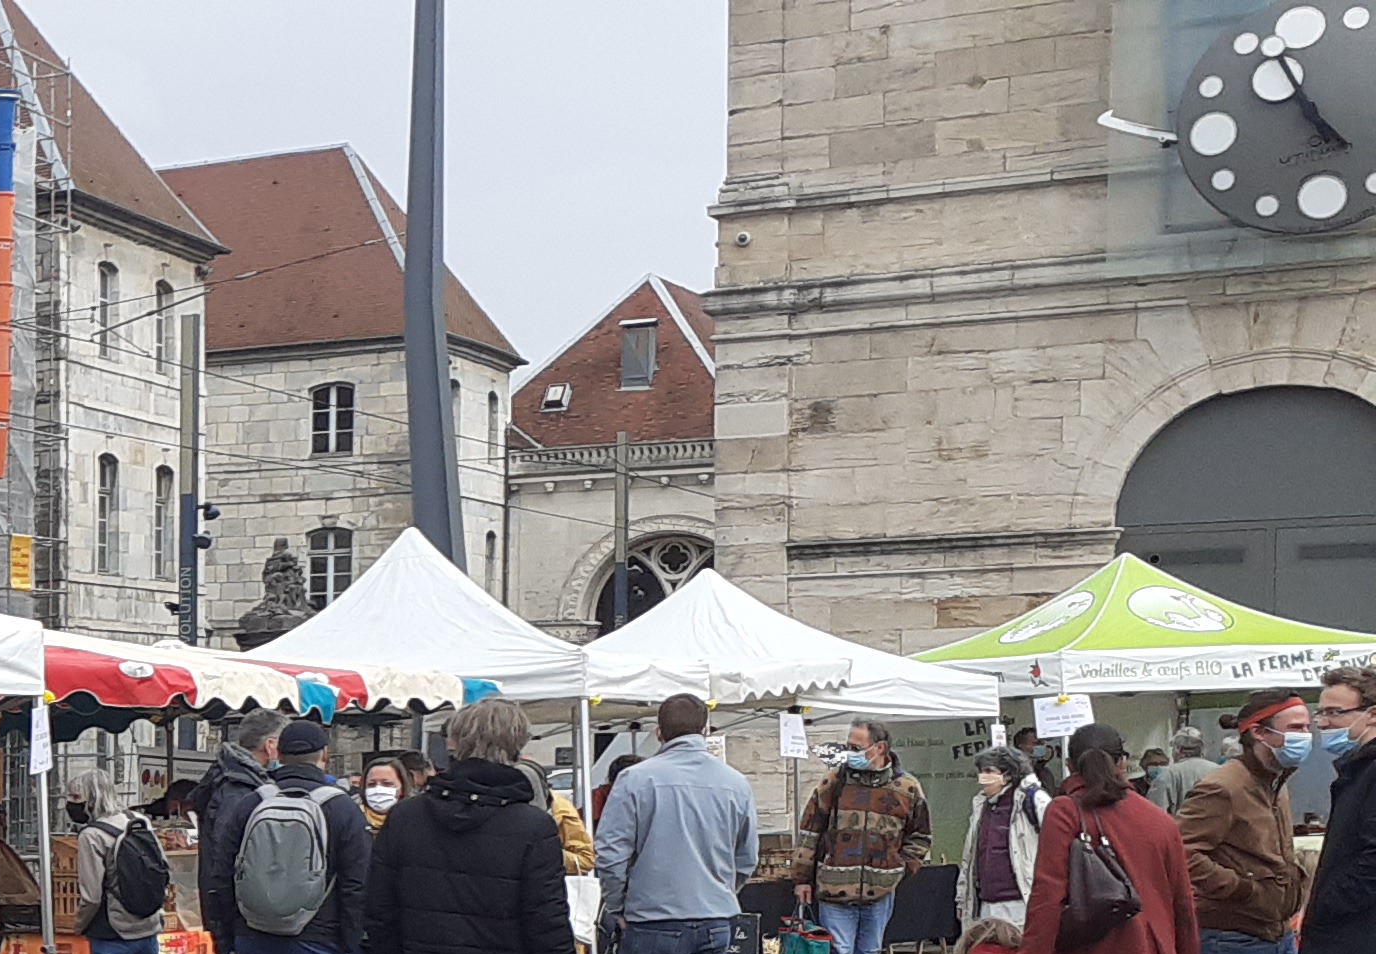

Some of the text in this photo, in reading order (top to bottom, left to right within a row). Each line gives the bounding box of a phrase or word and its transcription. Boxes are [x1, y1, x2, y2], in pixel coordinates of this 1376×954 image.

[1079, 663, 1137, 679] Volailles
[1141, 663, 1153, 676] &
[1195, 660, 1223, 676] BIO
[1231, 648, 1314, 679] LA FERME
[964, 719, 987, 737] LA
